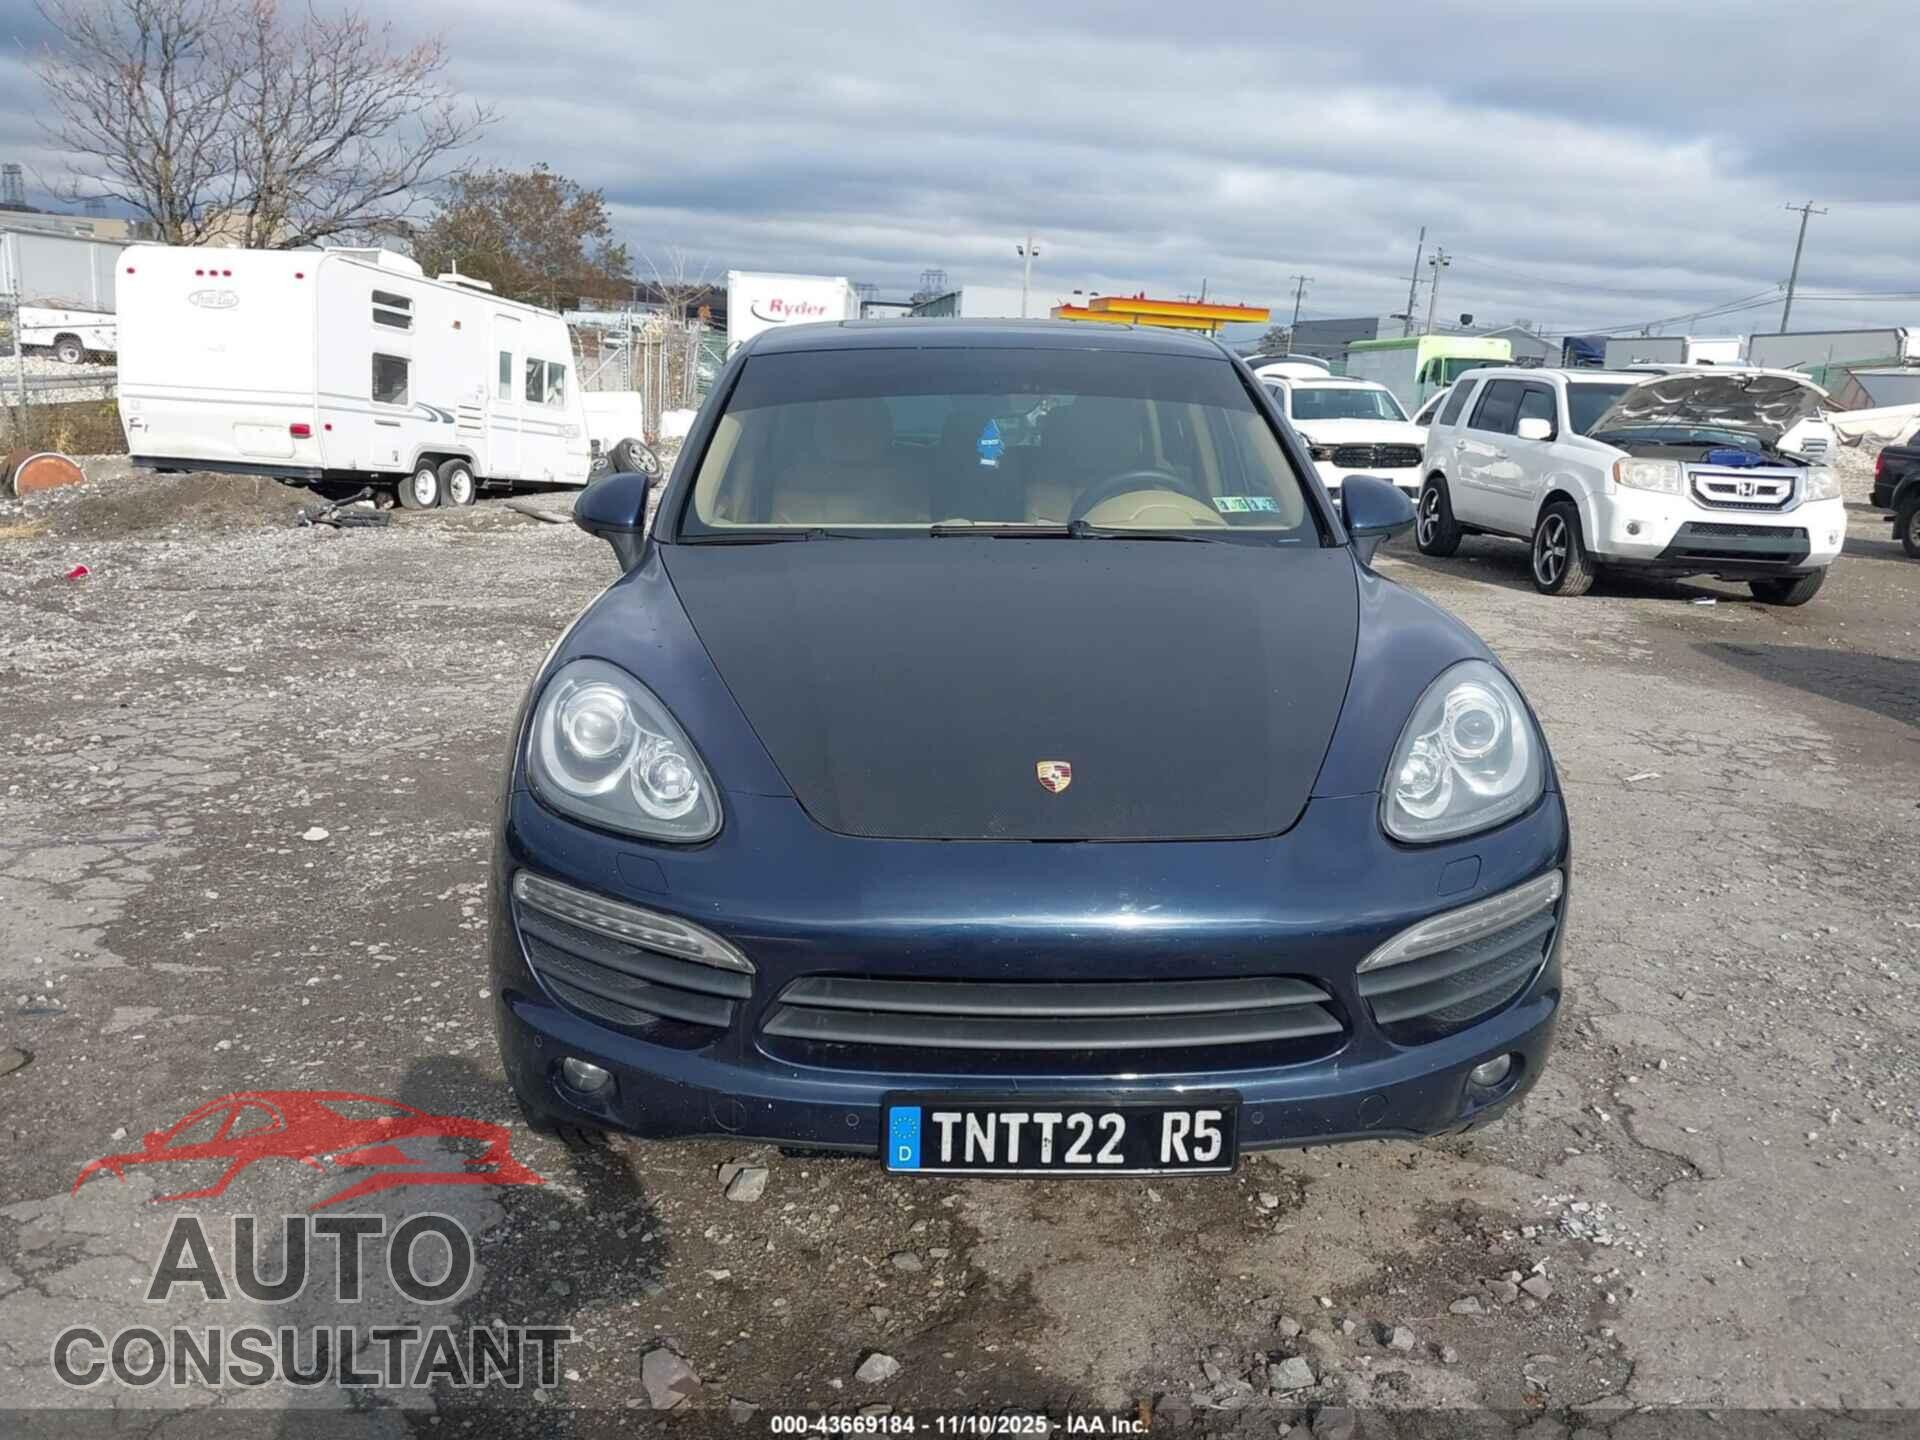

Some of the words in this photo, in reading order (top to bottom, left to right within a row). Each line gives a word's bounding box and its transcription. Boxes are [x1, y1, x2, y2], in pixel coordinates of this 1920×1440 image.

[769, 299, 827, 317] Ryder
[932, 1111, 1126, 1164] TNTT22
[1160, 1110, 1223, 1163] R5
[898, 1146, 912, 1162] D
